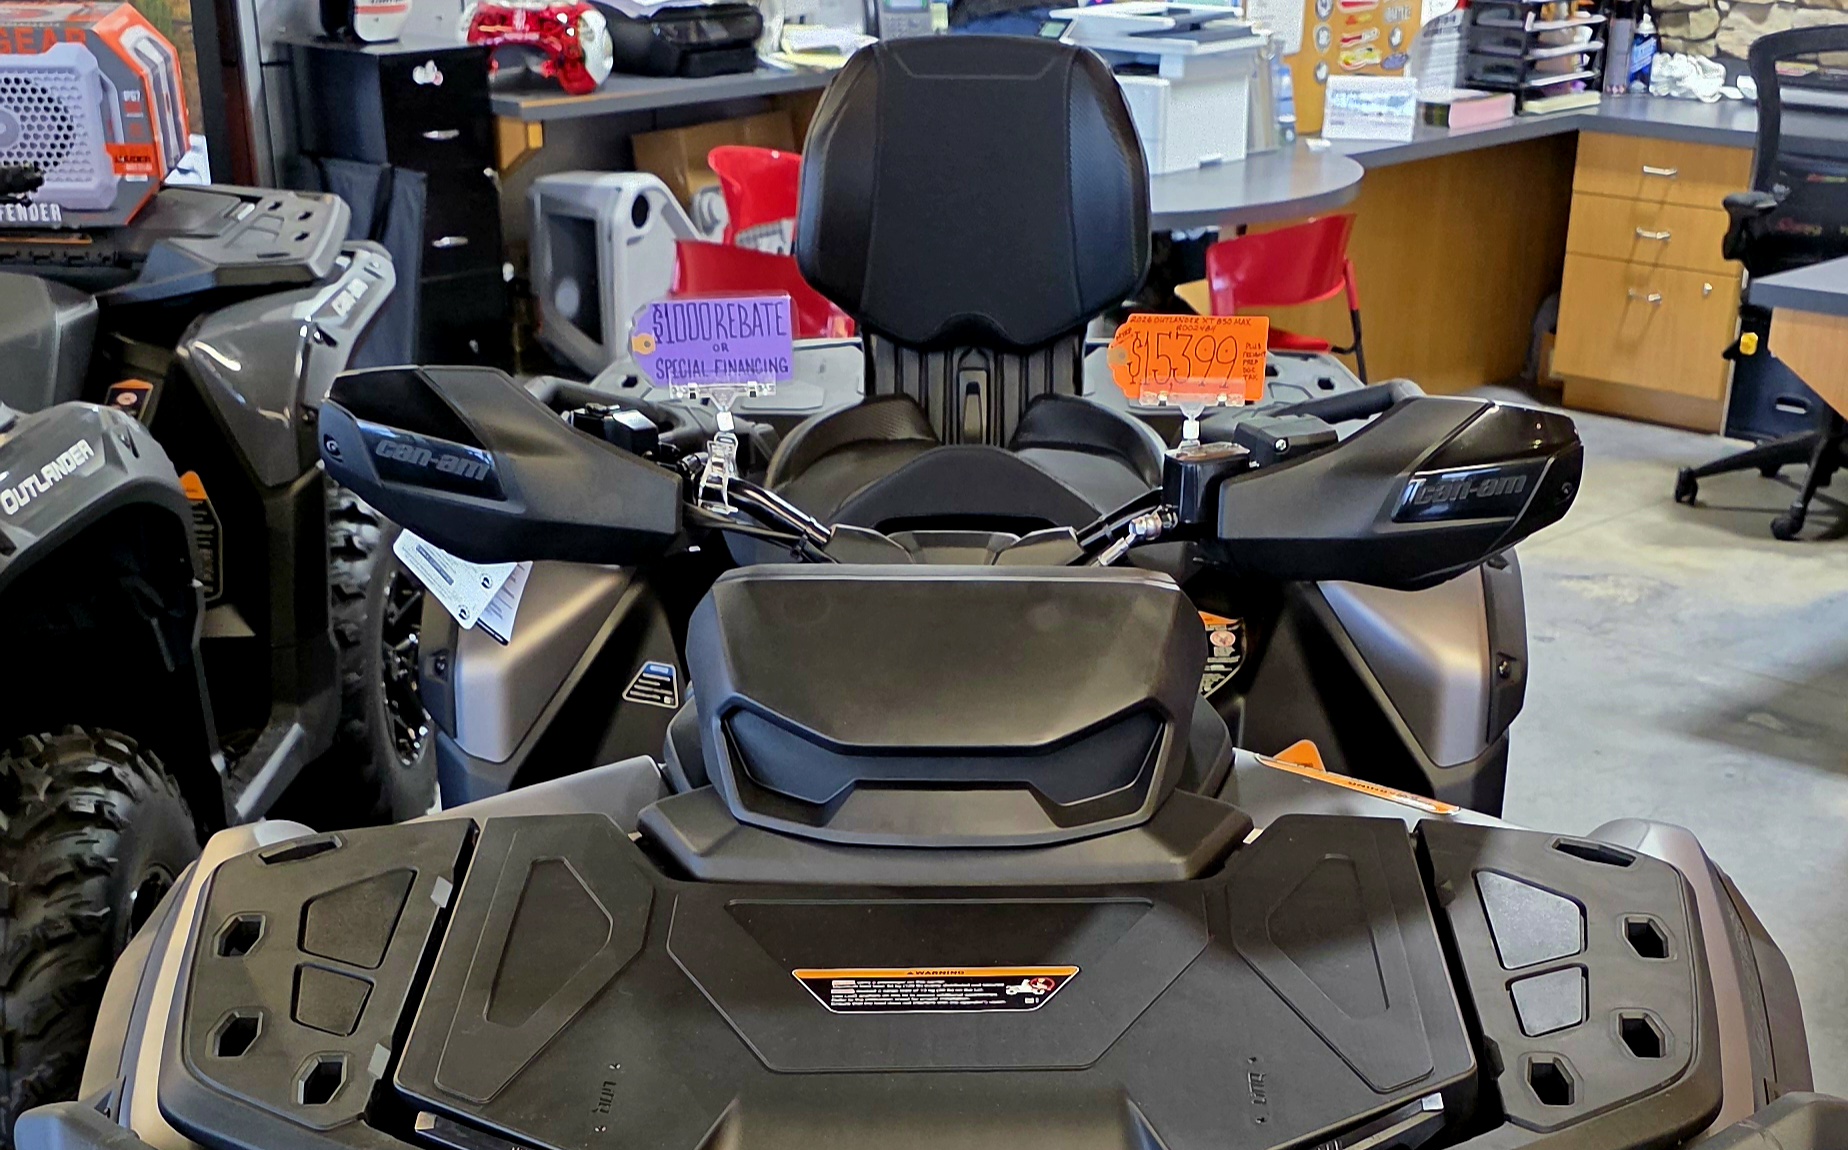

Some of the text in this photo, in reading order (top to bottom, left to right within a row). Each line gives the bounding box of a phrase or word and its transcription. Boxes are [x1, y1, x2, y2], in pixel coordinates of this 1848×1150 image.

[712, 343, 730, 352] OR
[656, 356, 789, 380] SPECIAL FINANCING
[375, 439, 492, 482] can-am
[0, 439, 95, 516] OUTLANDER
[1414, 474, 1527, 505] can-am
